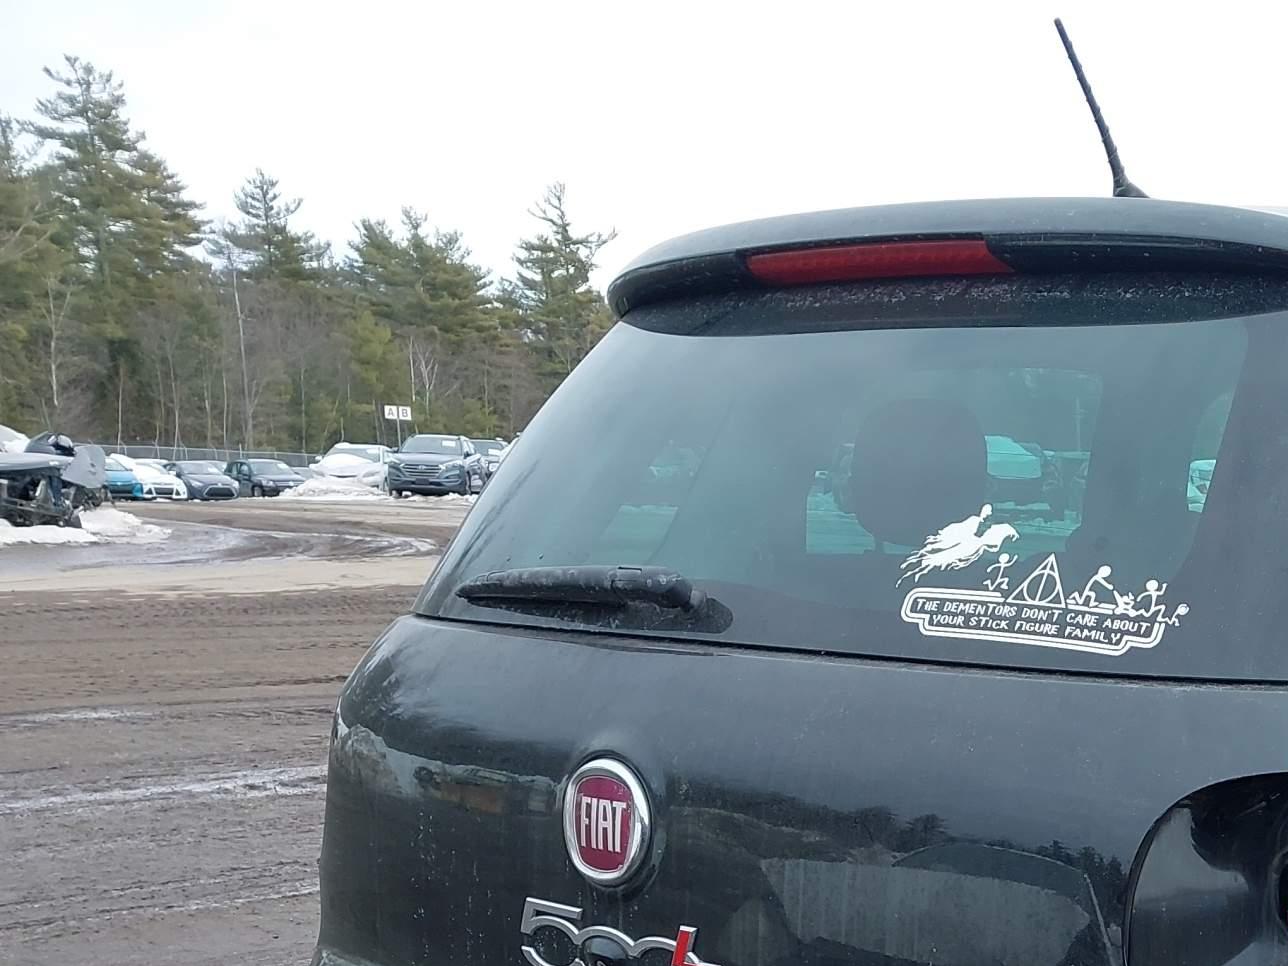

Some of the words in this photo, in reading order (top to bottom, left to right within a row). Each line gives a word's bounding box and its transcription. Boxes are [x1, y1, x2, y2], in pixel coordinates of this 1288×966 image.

[387, 408, 395, 417] A
[401, 408, 408, 418] B
[916, 599, 940, 611] THE
[943, 601, 1018, 618] DEMENTORS
[1021, 607, 1063, 622] DON'T
[1066, 612, 1100, 627] CARE
[1102, 618, 1151, 635] ABOUT
[932, 614, 965, 627] YOUR
[968, 616, 1010, 630] STICK
[1014, 620, 1060, 635] FIGURE
[1064, 625, 1121, 644] FAMILY
[580, 796, 626, 853] FIAT
